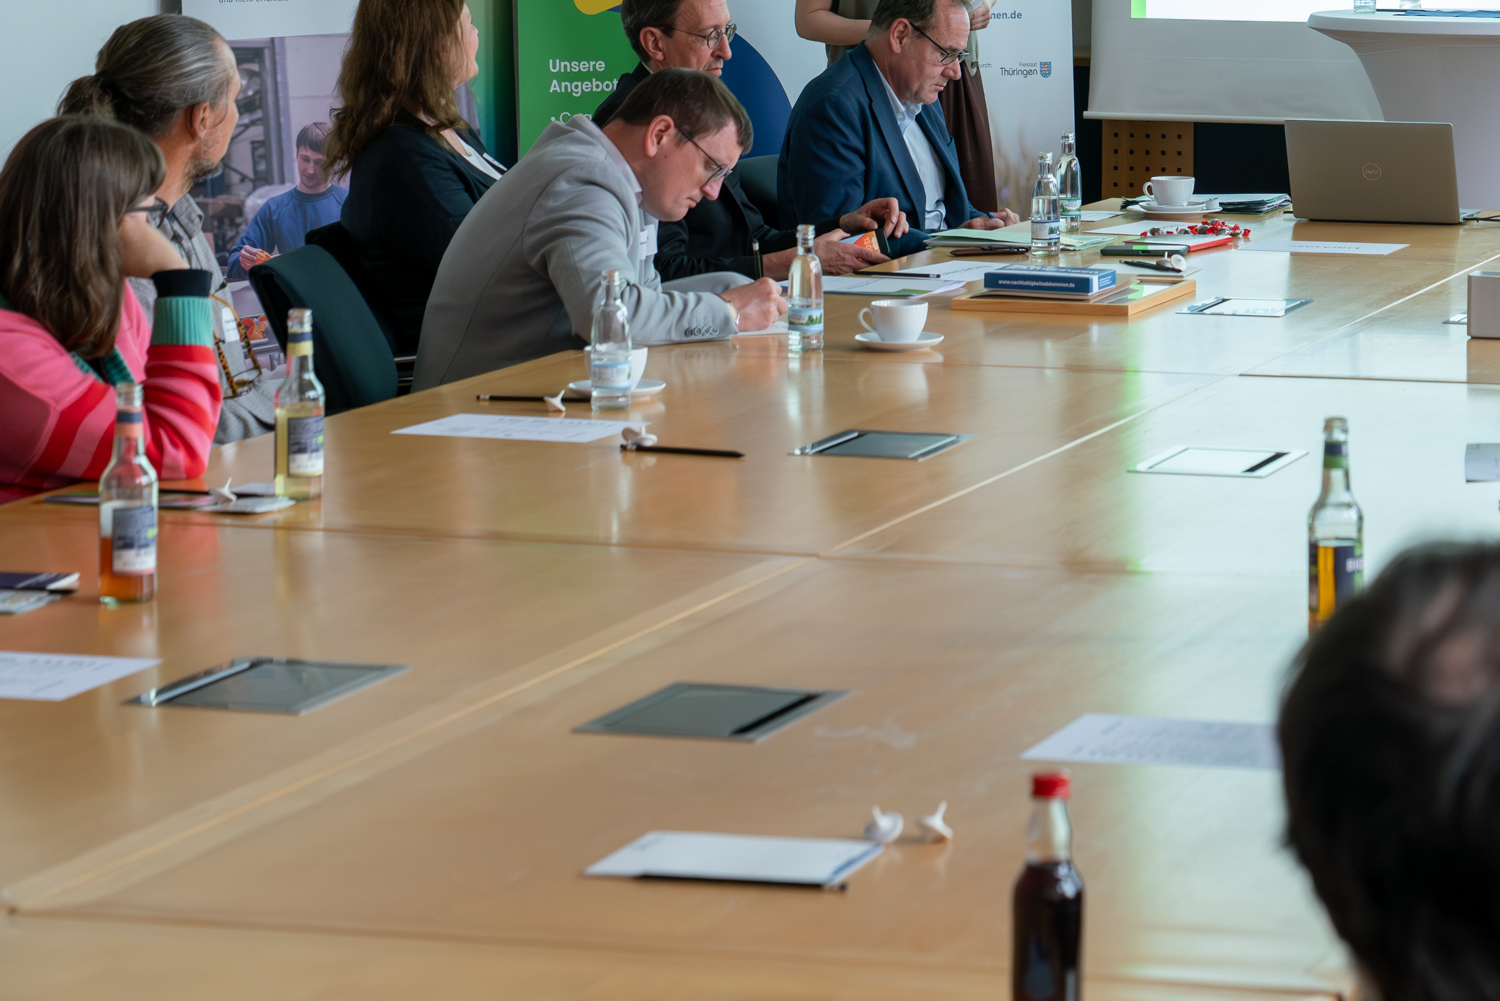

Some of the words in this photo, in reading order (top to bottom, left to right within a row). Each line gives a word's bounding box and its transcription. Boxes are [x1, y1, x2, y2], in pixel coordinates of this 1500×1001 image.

[549, 58, 606, 73] Unsere
[1000, 67, 1038, 78] Thüringen
[549, 77, 618, 97] Angebot
